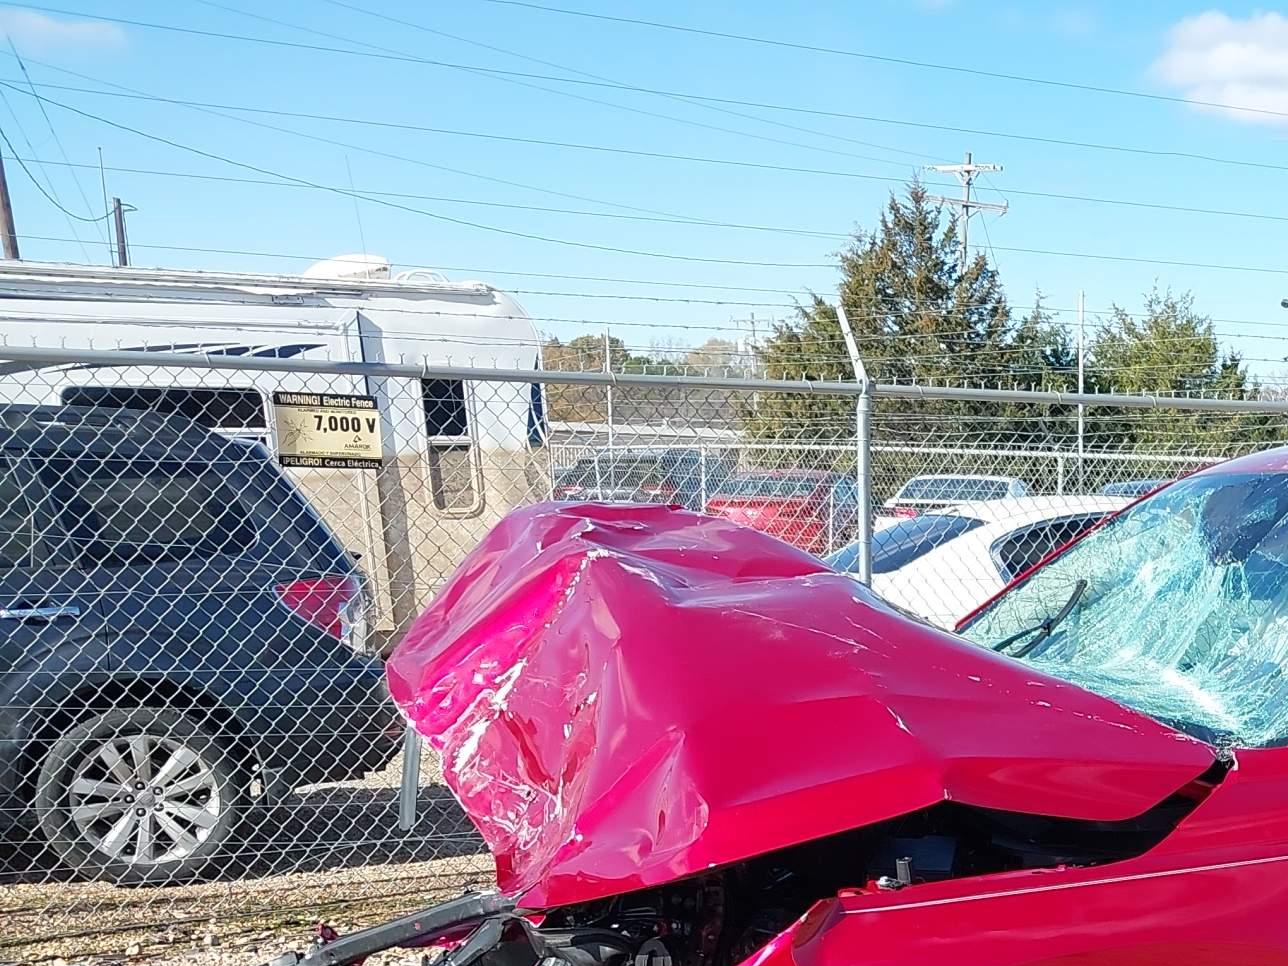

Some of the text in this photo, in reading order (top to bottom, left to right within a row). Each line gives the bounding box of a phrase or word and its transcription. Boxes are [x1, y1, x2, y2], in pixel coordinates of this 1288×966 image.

[279, 394, 373, 408] WARNING! Electric Fence
[314, 415, 376, 433] 7,000 V
[325, 459, 346, 467] Cerca
[347, 459, 379, 469] Eléctrica
